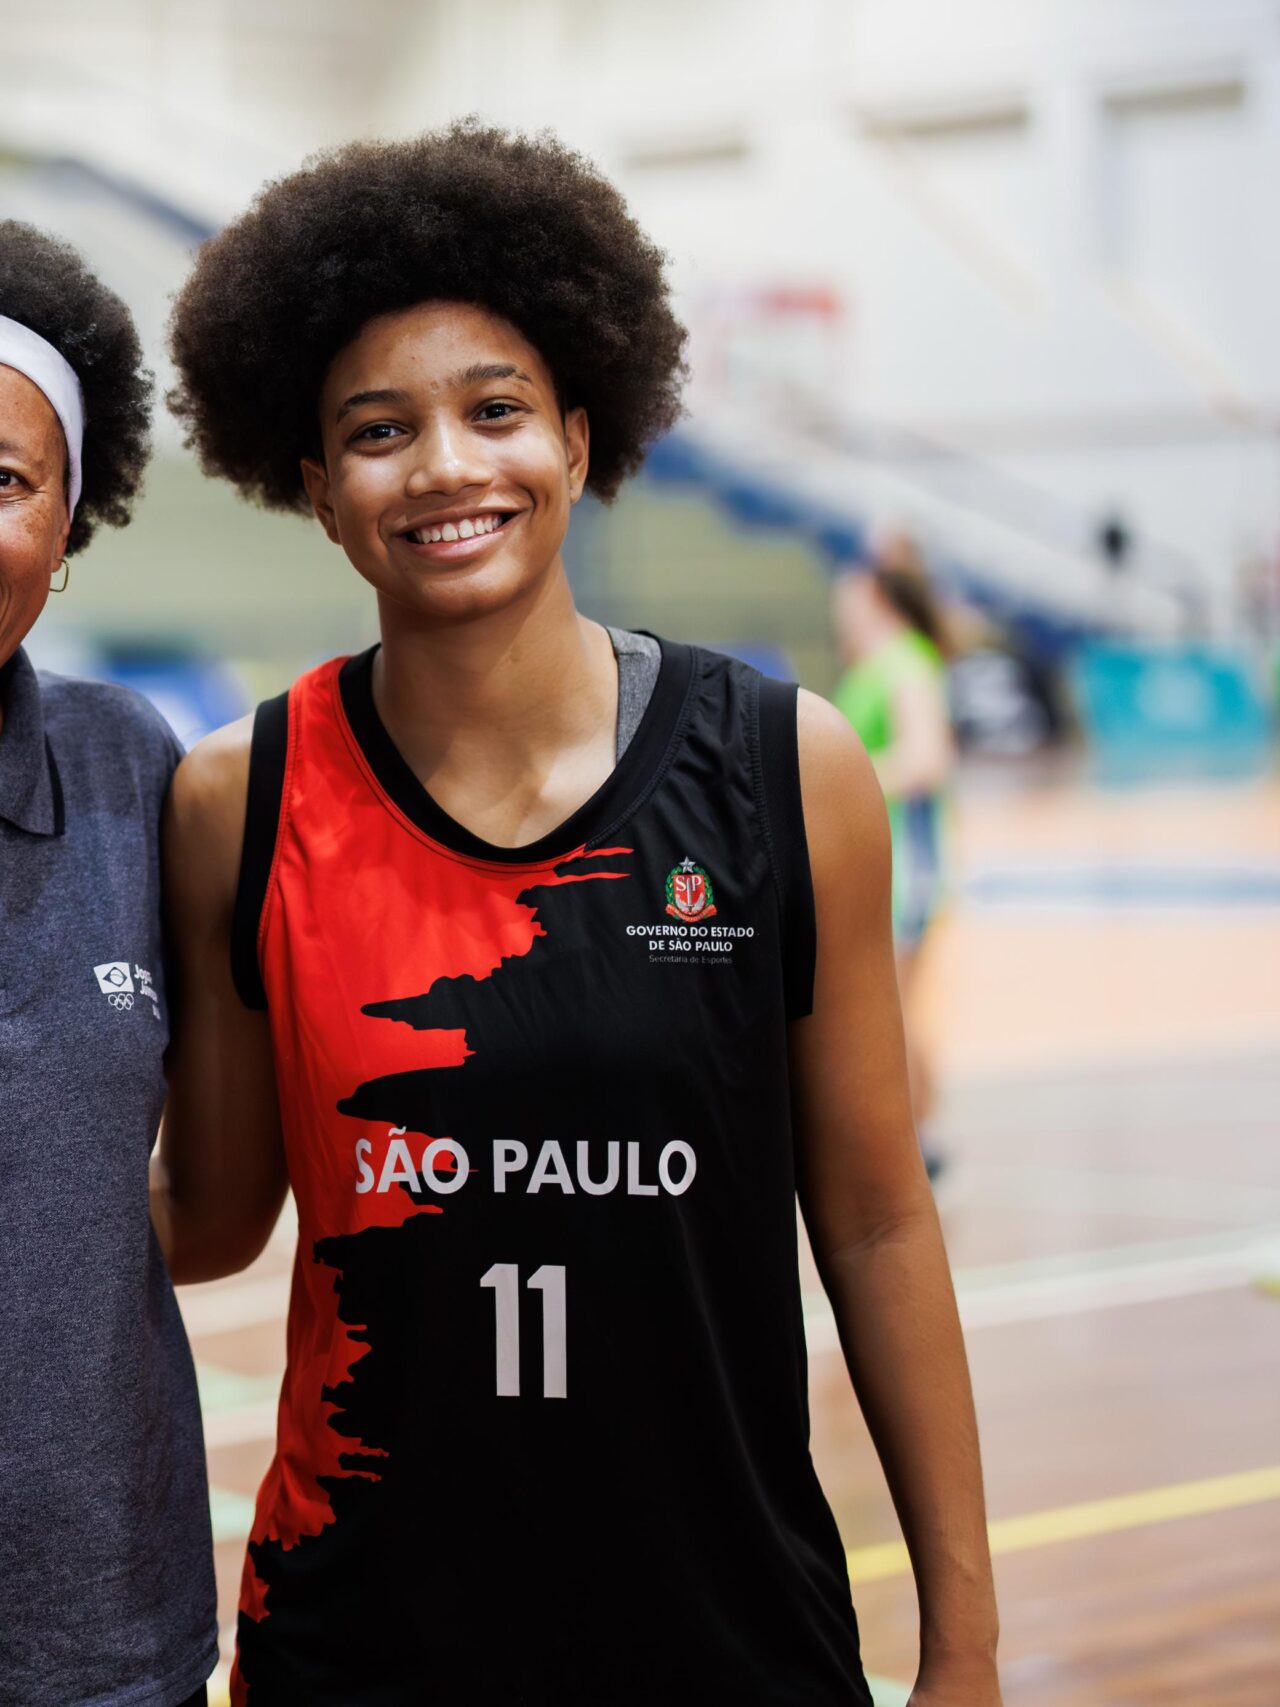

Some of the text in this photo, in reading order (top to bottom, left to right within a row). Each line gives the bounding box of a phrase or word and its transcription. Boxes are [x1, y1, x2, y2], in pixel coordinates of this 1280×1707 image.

[626, 925, 754, 938] GOVERNO DO ESTADO
[648, 937, 733, 952] DE SÃO PAULO
[355, 1126, 697, 1196] SÃO PAULO
[479, 1262, 568, 1399] 11
